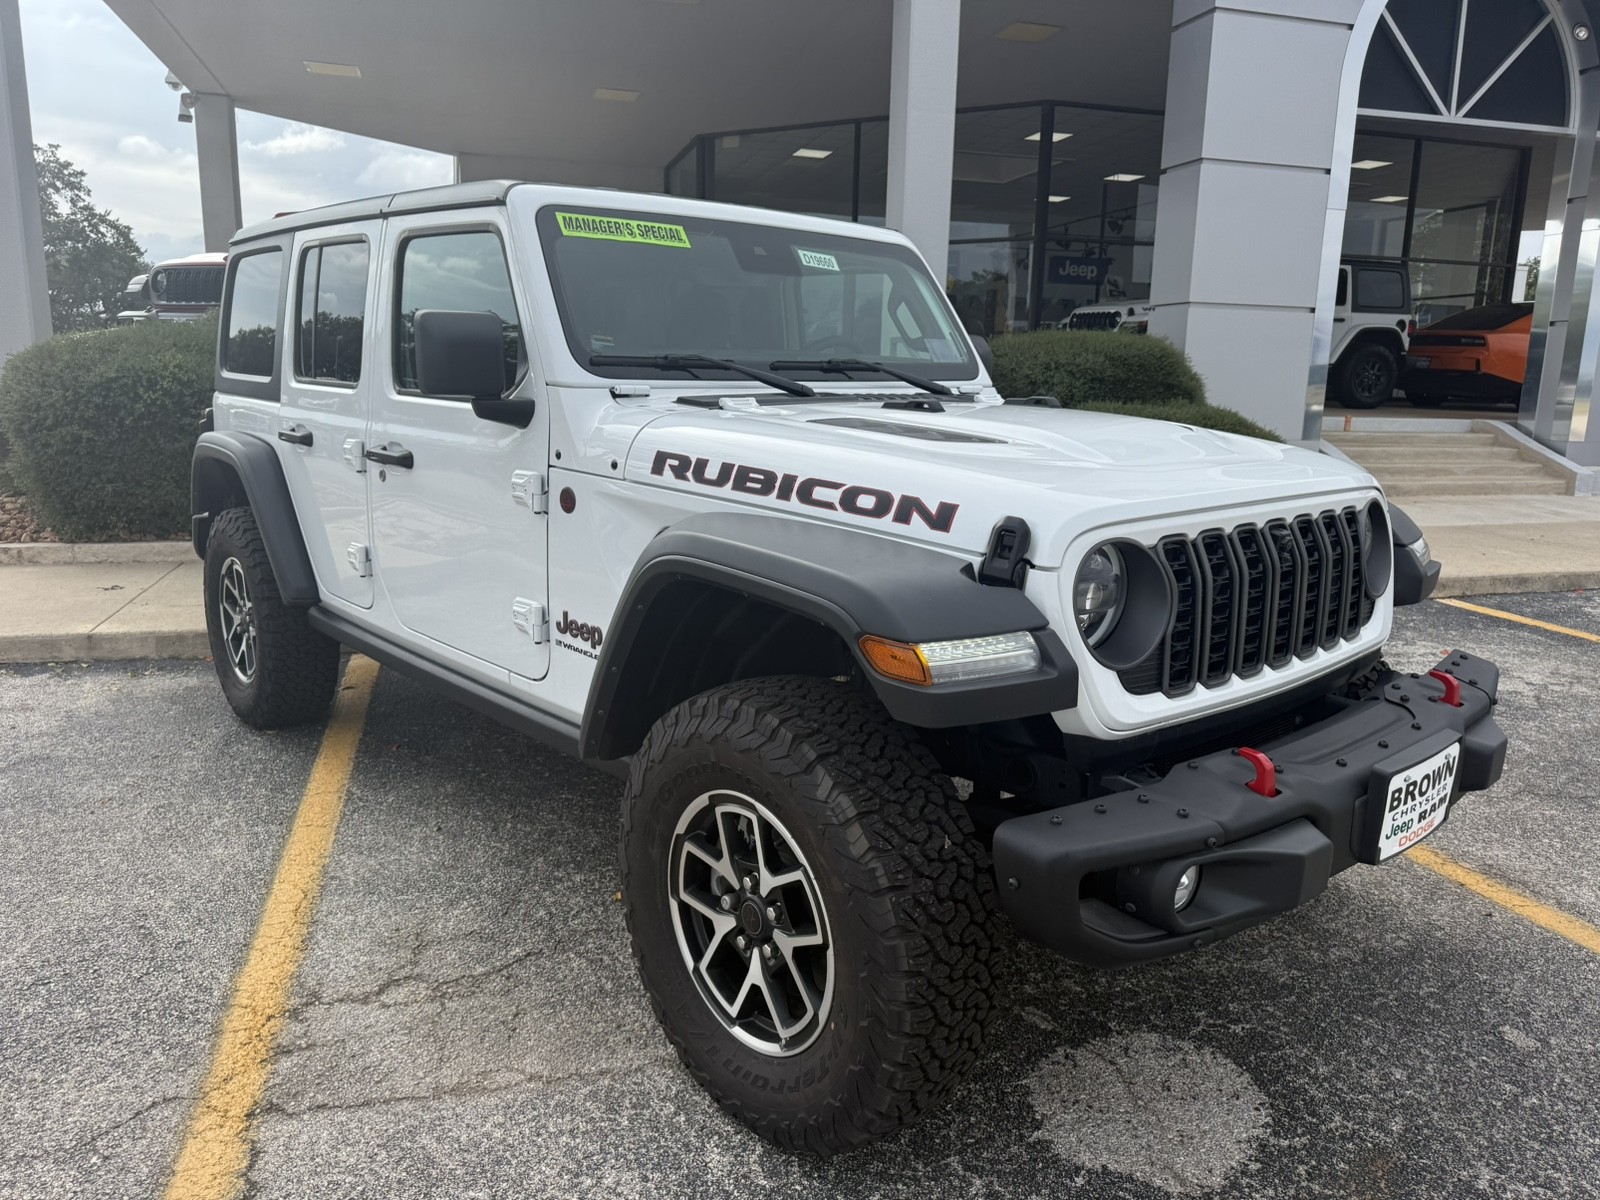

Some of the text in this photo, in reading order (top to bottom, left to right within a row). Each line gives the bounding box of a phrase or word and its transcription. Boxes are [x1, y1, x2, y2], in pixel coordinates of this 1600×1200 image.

[561, 215, 685, 242] MANAGER'S SPECIAL
[1058, 260, 1098, 280] Jeep
[650, 449, 960, 534] RUBICON
[555, 609, 603, 650] Jeep
[562, 642, 599, 660] WRANGLE
[1388, 755, 1456, 813] BROWN
[1391, 782, 1448, 822] CHRYSLER
[1385, 792, 1449, 840] Jeep RAM
[1398, 816, 1436, 848] DODGE
